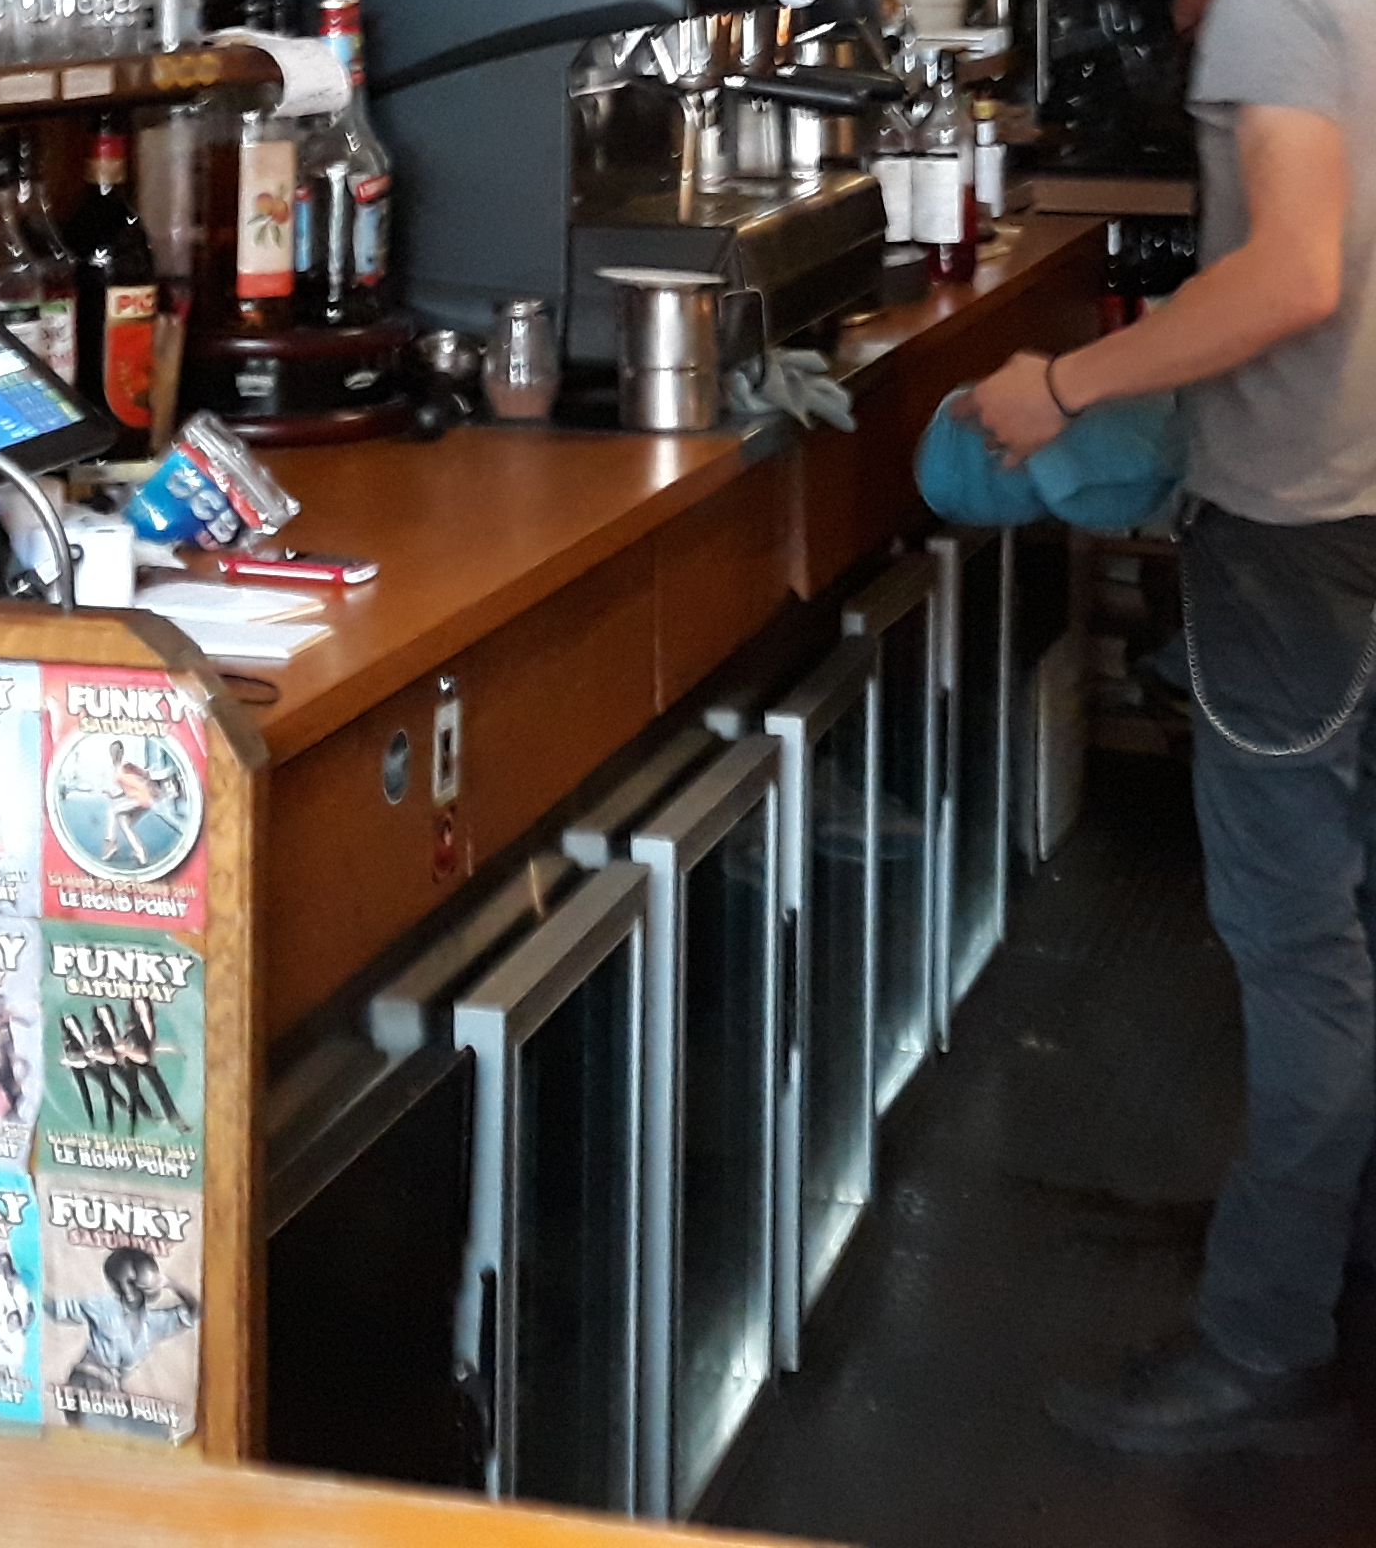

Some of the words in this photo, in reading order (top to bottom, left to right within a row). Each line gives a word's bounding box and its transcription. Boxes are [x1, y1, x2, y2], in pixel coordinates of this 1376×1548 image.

[67, 683, 187, 722] FUNKY
[60, 887, 80, 908] LE
[81, 890, 133, 914] ROND
[134, 895, 189, 919] POINT
[52, 942, 194, 987] FUNKY
[66, 978, 177, 1003] SATURDAY
[53, 1142, 77, 1165] LE
[134, 1152, 193, 1180] POINT
[50, 1194, 191, 1242] FUNKY
[55, 1387, 79, 1410] LE
[80, 1394, 129, 1417] ROND
[130, 1399, 180, 1429] POINT
